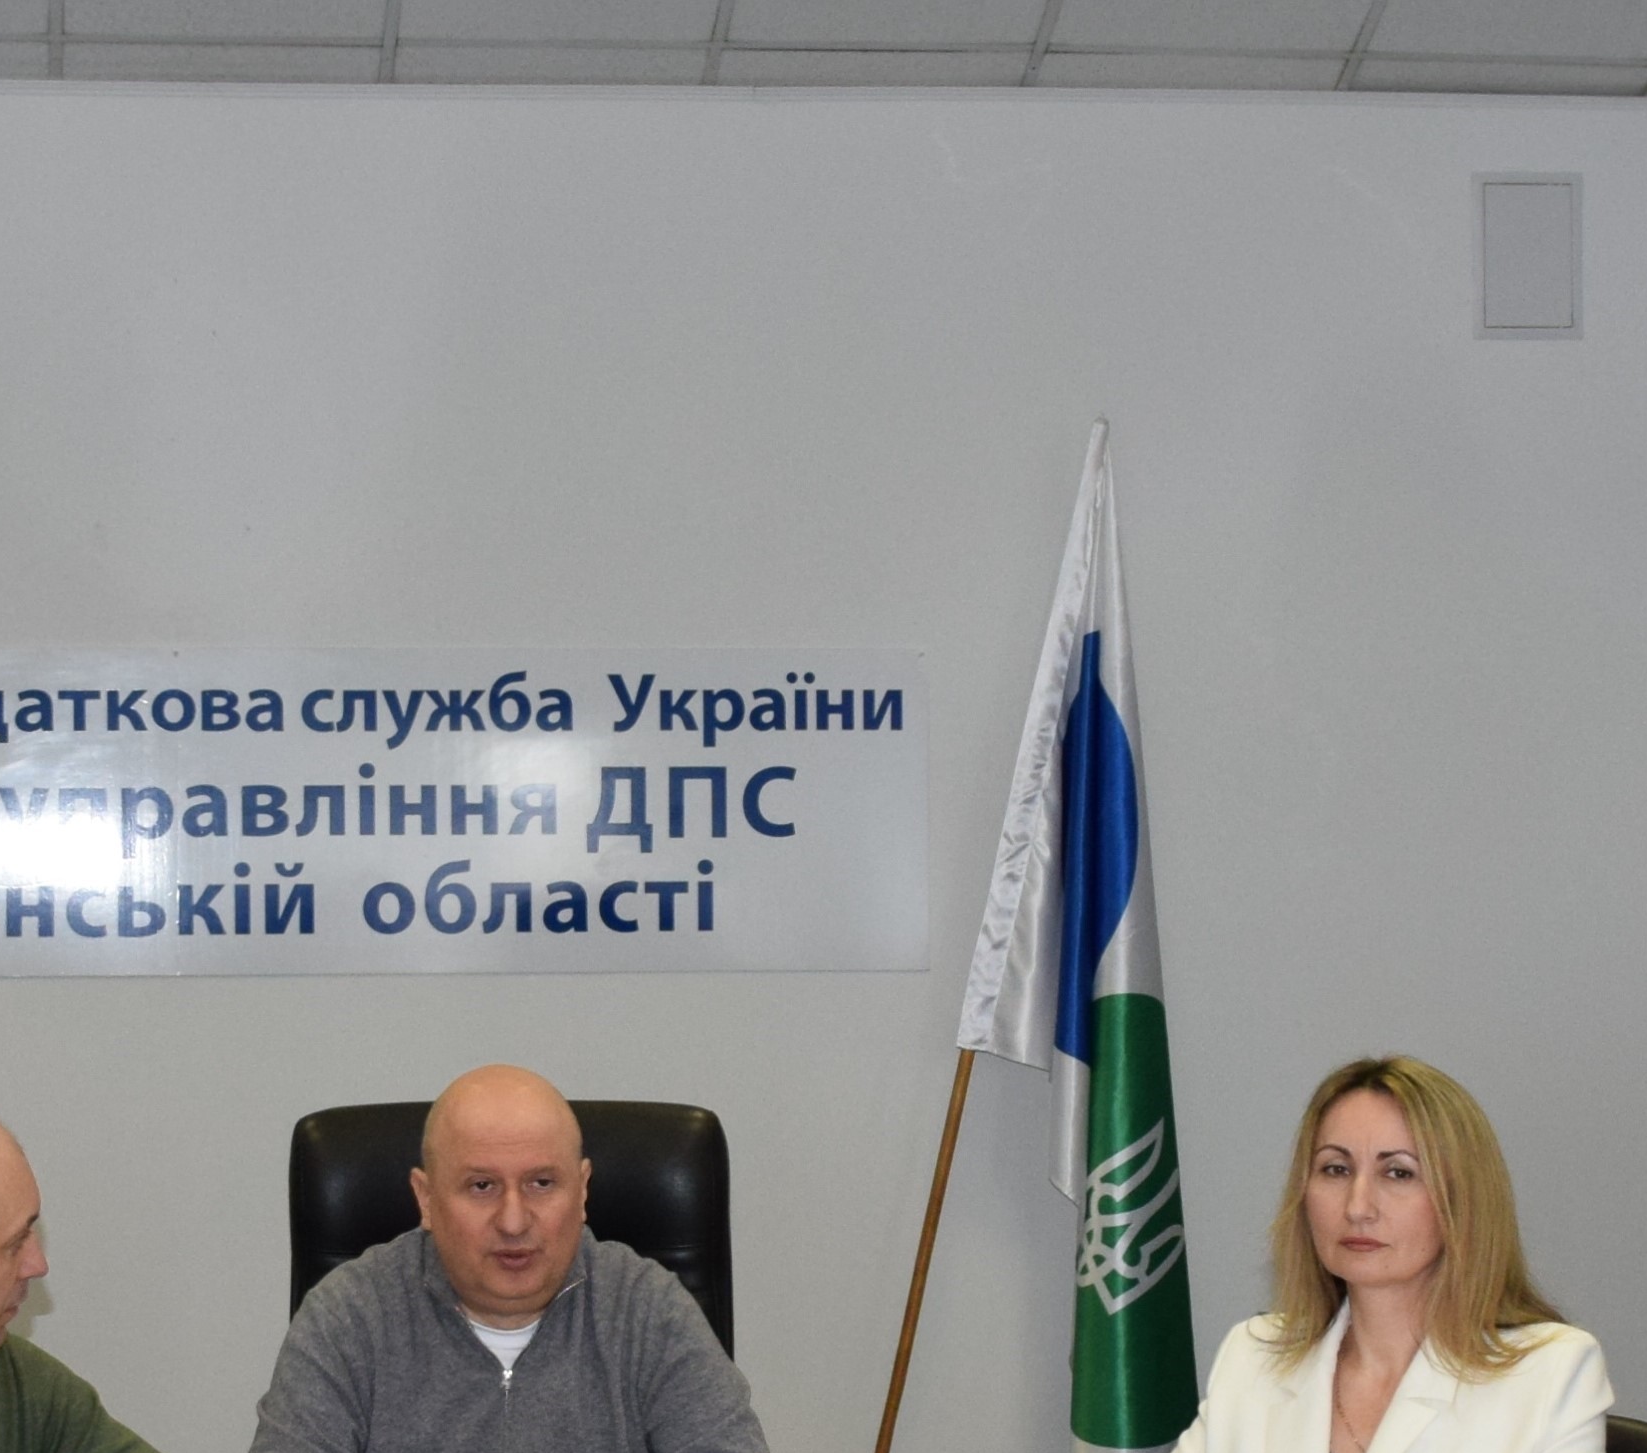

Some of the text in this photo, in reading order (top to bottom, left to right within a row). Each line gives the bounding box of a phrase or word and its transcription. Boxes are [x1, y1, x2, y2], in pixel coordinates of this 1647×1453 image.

[301, 671, 574, 750] служба
[607, 672, 903, 747] України
[586, 765, 797, 853] ДПС
[363, 859, 714, 934] області
